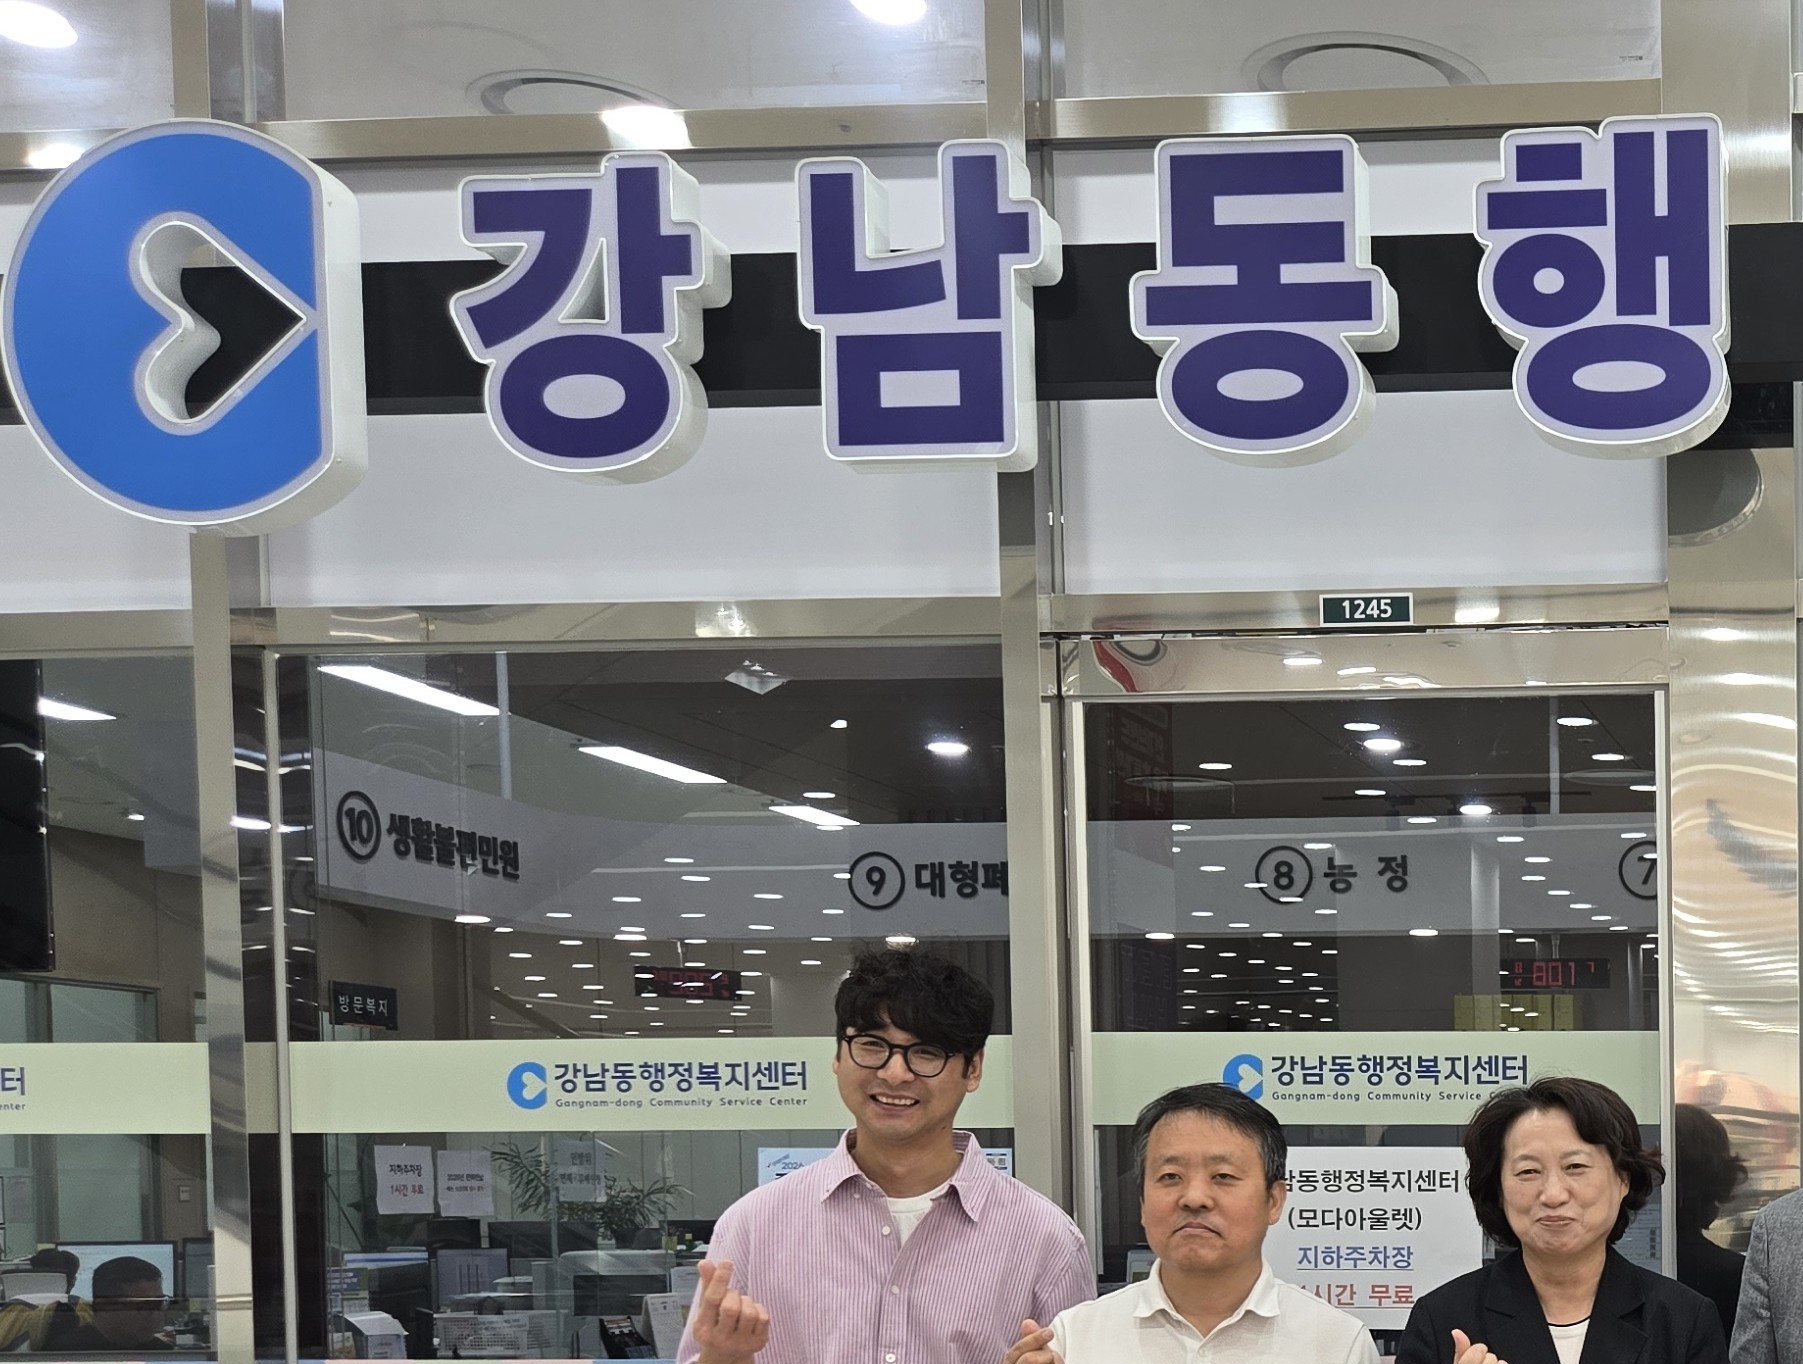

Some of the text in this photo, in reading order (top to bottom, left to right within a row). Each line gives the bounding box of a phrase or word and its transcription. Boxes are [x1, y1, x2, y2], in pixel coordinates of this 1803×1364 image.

[1341, 600, 1392, 618] 1245
[387, 812, 521, 880] 생활불편민원
[554, 1061, 807, 1093] 강남동행정복지센터
[1271, 1054, 1529, 1086] 강남동행정복지센터
[555, 1097, 807, 1108] Gangnam-dong Community Service Center
[1272, 1090, 1482, 1102] Gangnam-dong Community Service
[1288, 1207, 1422, 1230] (모다아울렛)
[1298, 1245, 1413, 1268] 지하주차장
[1368, 1284, 1415, 1306] 무료
